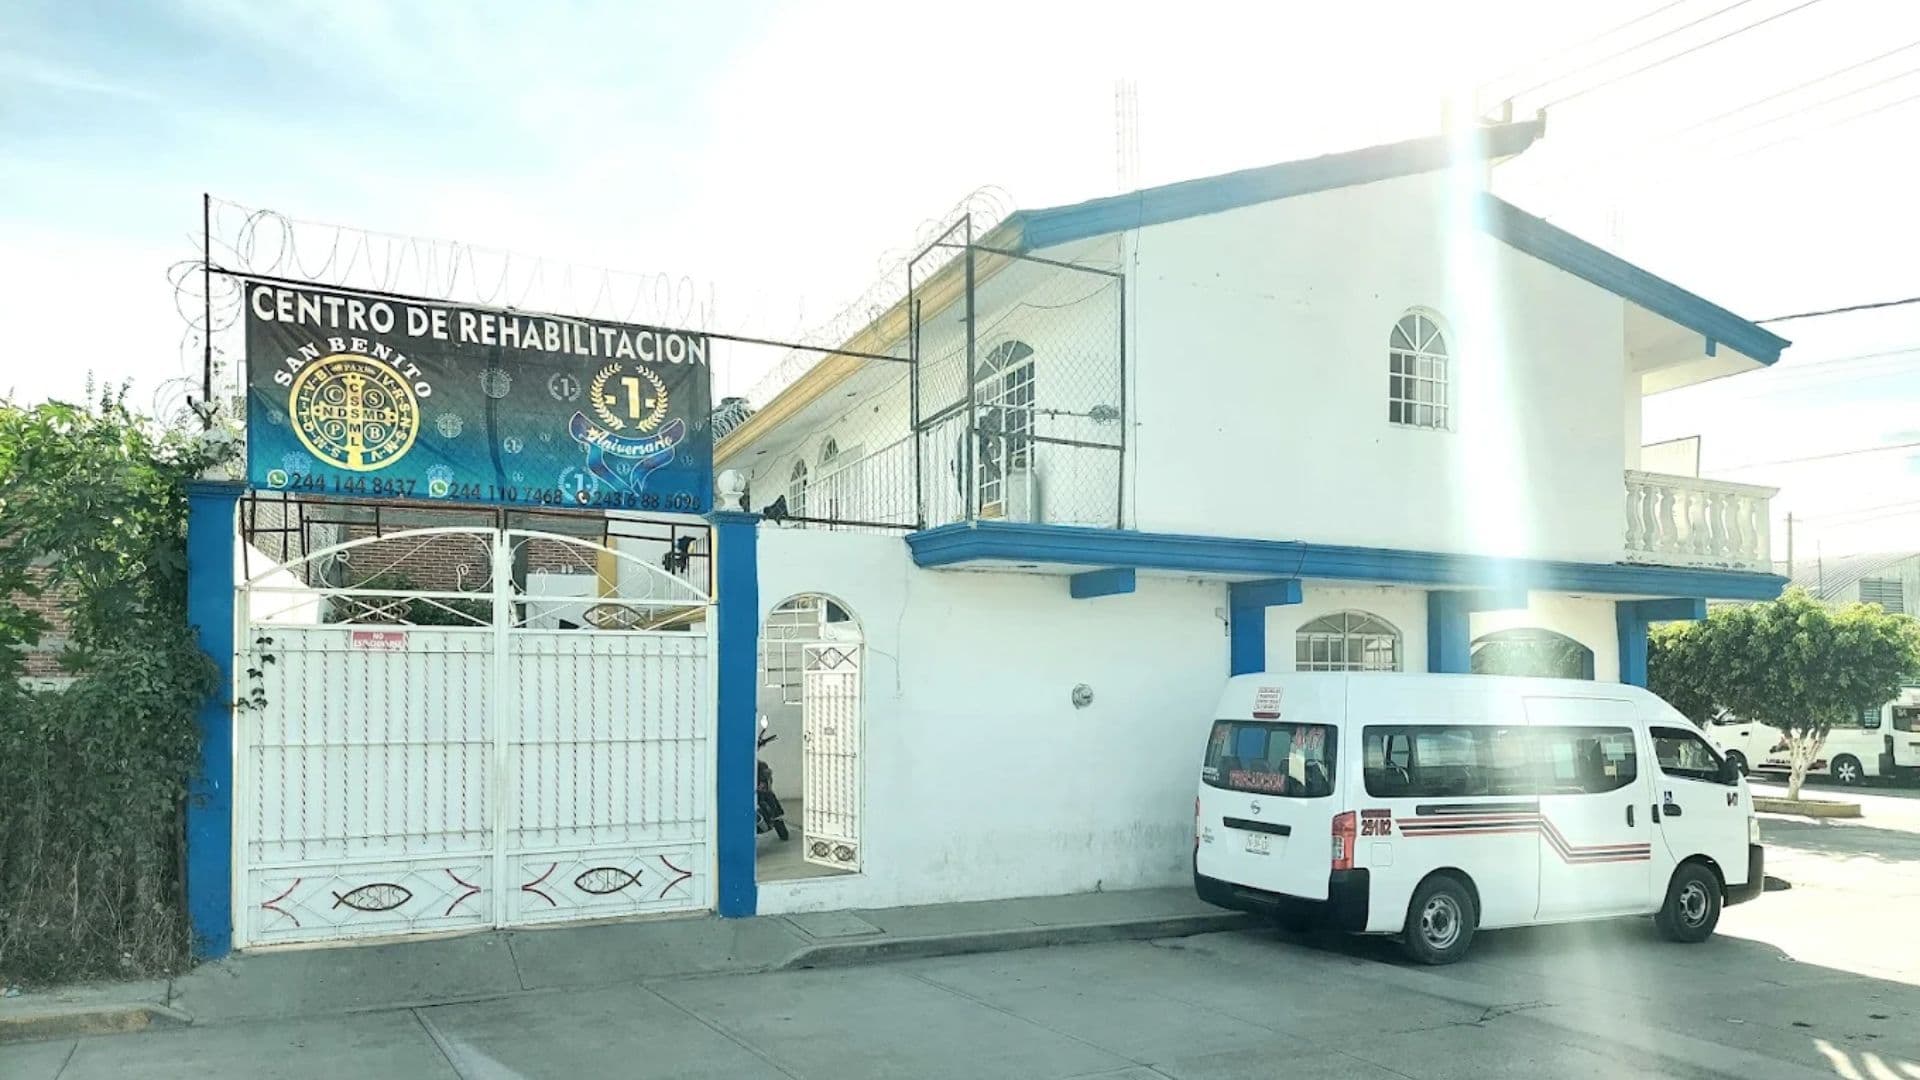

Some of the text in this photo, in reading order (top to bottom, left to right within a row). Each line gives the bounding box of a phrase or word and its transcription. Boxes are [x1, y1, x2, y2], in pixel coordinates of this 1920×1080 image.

[251, 285, 707, 367] CENTRO DE REHABILITACION
[274, 337, 433, 399] SAN BENITO
[291, 473, 325, 490] 244
[334, 475, 366, 494] 144
[447, 482, 481, 500] 244
[372, 632, 385, 640] NO
